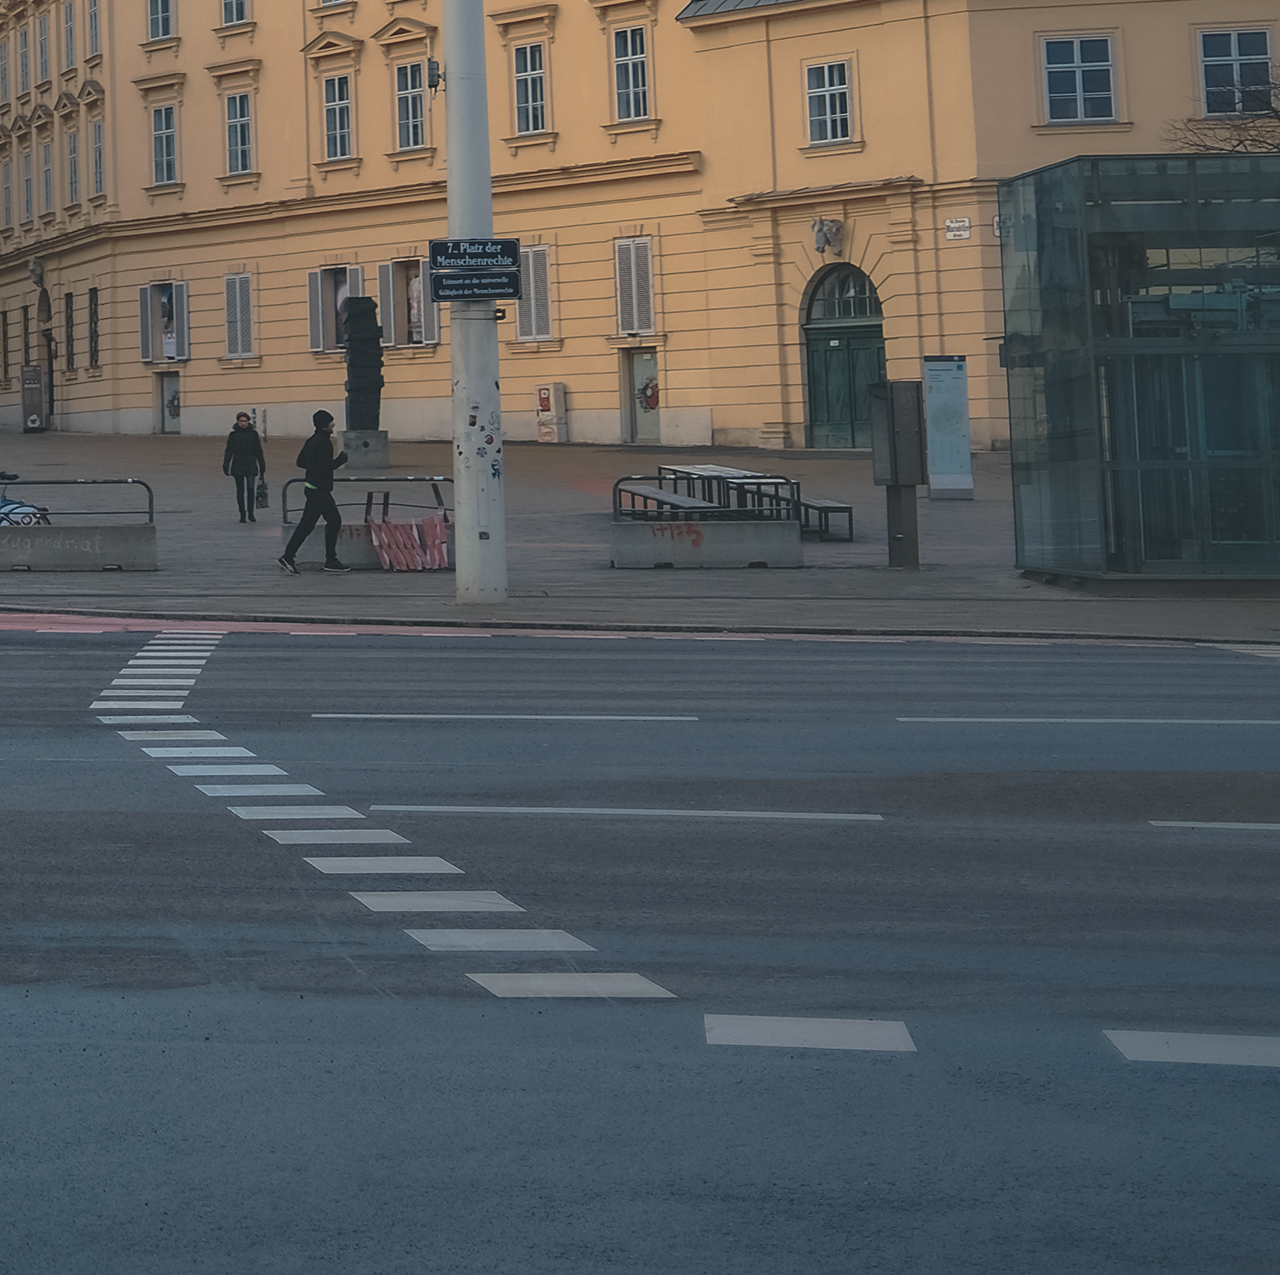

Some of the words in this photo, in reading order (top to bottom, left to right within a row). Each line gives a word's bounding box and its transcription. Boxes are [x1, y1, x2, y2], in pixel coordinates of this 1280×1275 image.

[459, 242, 484, 253] Platz
[485, 242, 502, 253] der
[436, 254, 514, 266] Menschenrechte
